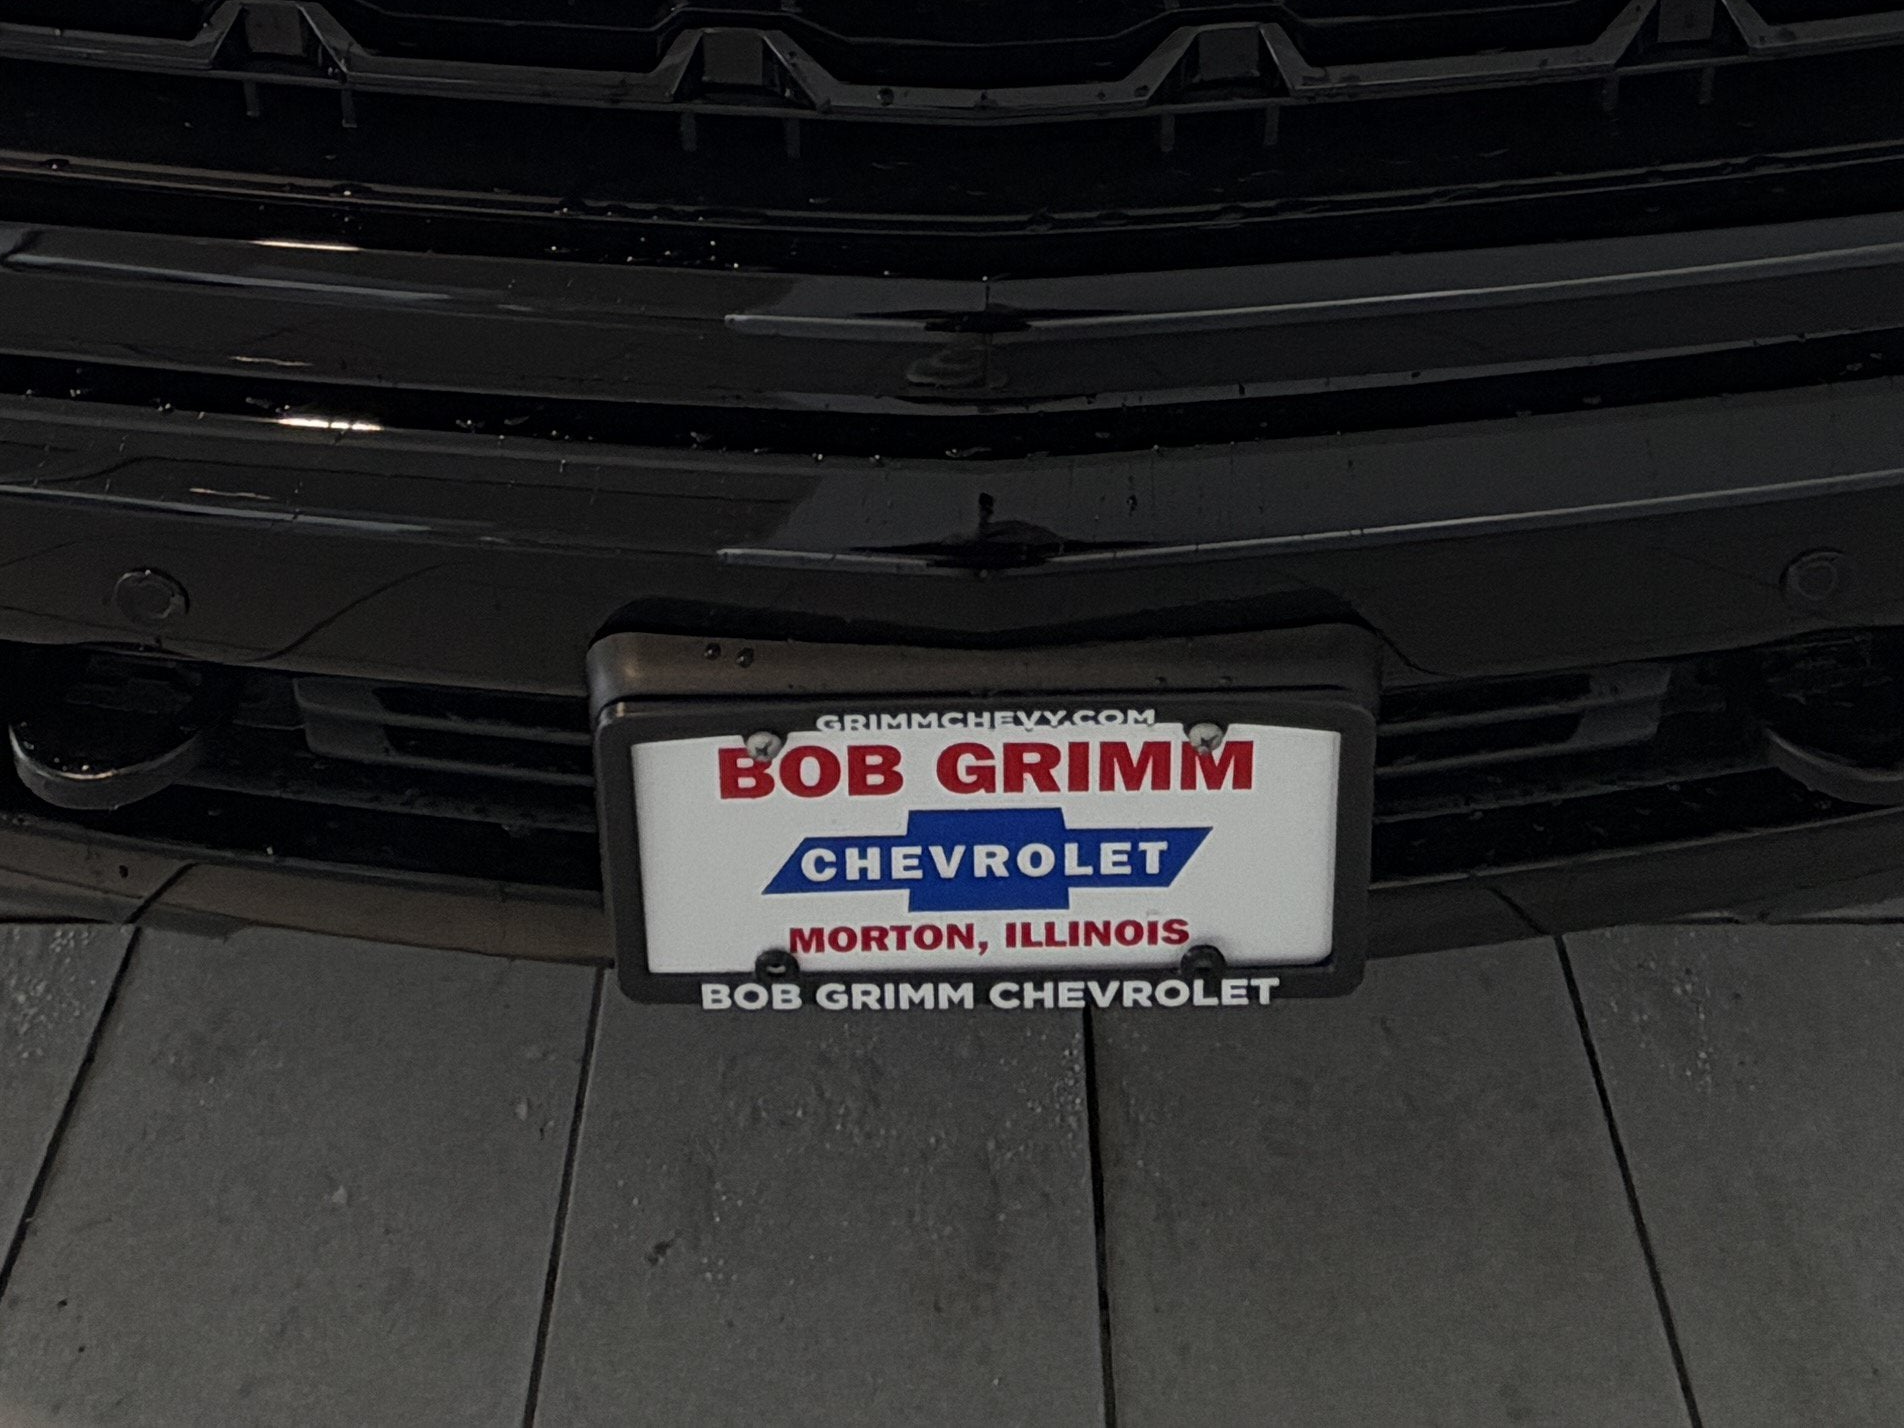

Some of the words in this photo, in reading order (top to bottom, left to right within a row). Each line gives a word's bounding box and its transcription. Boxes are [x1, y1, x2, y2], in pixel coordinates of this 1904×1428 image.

[815, 708, 1156, 734] GRIMMCHEVY.COM
[717, 743, 904, 800] BOB
[935, 740, 1255, 795] GRIMM
[799, 840, 1169, 882] CHEVROLET
[788, 922, 989, 956] MORTON,
[1004, 918, 1190, 950] ILLINOIS
[700, 980, 802, 1011] BOB
[815, 981, 975, 1011] GRIMM
[988, 977, 1282, 1011] CHEVROLET
